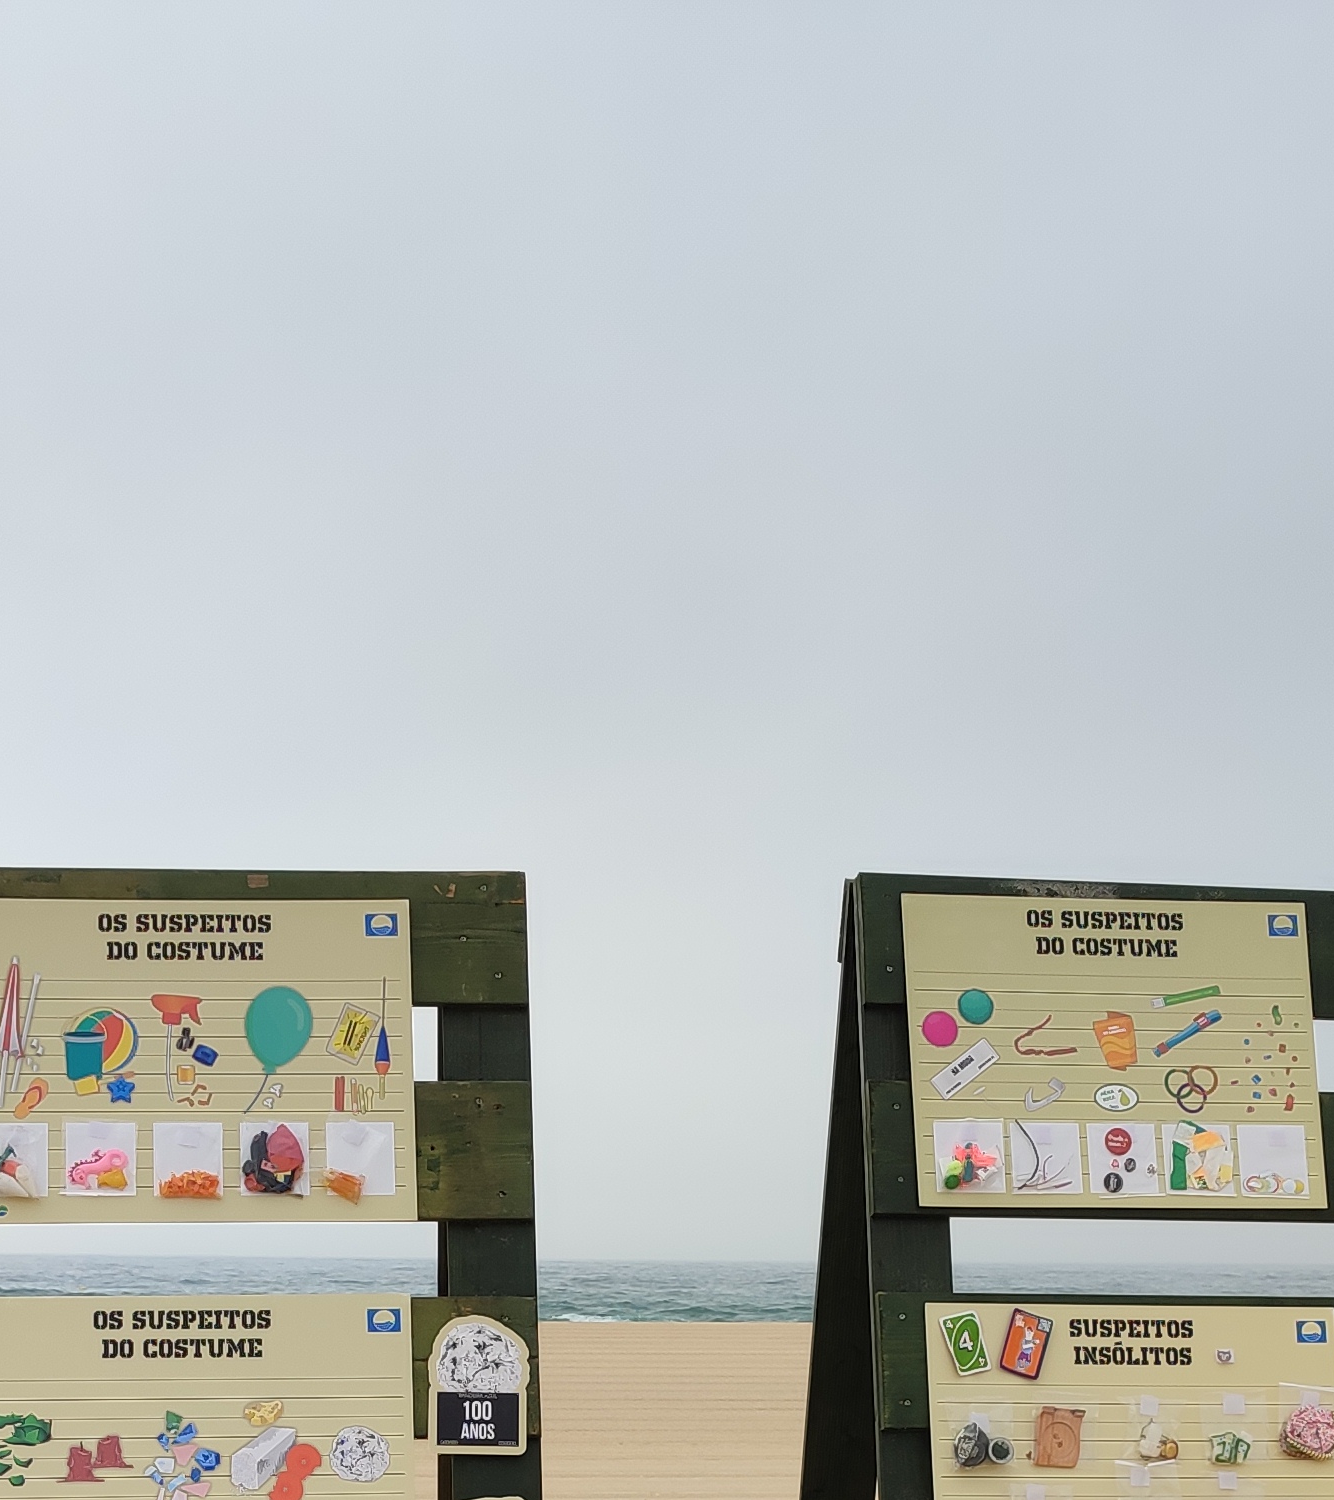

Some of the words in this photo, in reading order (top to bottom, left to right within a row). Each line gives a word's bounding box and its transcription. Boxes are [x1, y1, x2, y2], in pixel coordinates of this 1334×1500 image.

[98, 913, 128, 933] OS
[135, 914, 272, 934] SUSPEITOS
[1026, 910, 1053, 928] OS
[1061, 910, 1184, 931] SUSPEITOS
[106, 941, 138, 961] DO
[147, 941, 264, 961] COSTUME
[1036, 936, 1064, 955] DO
[1072, 937, 1178, 957] COSTUME
[93, 1310, 124, 1330] OS
[132, 1309, 272, 1330] SUSPEITOS
[1069, 1319, 1194, 1338] SUSPEITOS
[101, 1338, 134, 1358] DO
[143, 1338, 263, 1358] COSTUME
[959, 1330, 973, 1351] 4
[1073, 1341, 1192, 1366] INSÓLITOS
[462, 1401, 492, 1421] 100
[460, 1423, 495, 1441] ANOS
